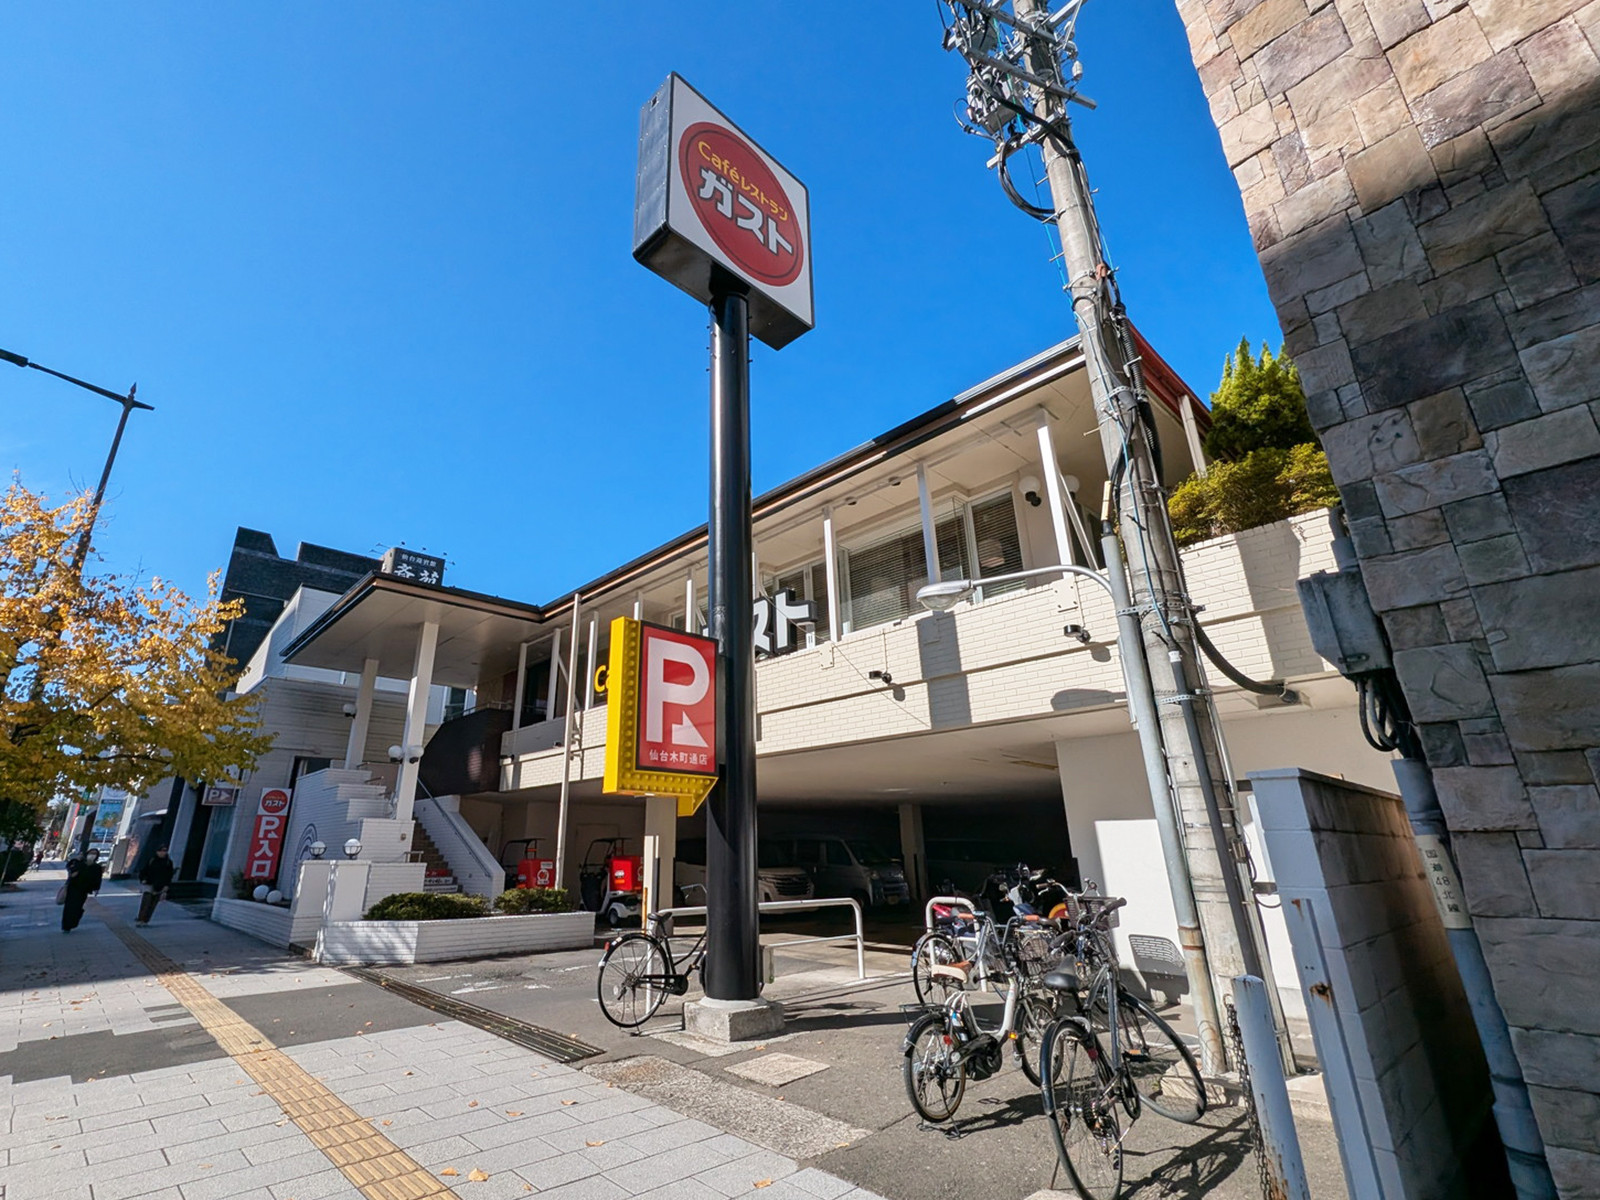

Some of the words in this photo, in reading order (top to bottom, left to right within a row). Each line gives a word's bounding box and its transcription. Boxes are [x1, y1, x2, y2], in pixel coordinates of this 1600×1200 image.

[699, 167, 793, 255] ガスト
[646, 636, 710, 743] P
[649, 749, 708, 766] 仙台木町通店
